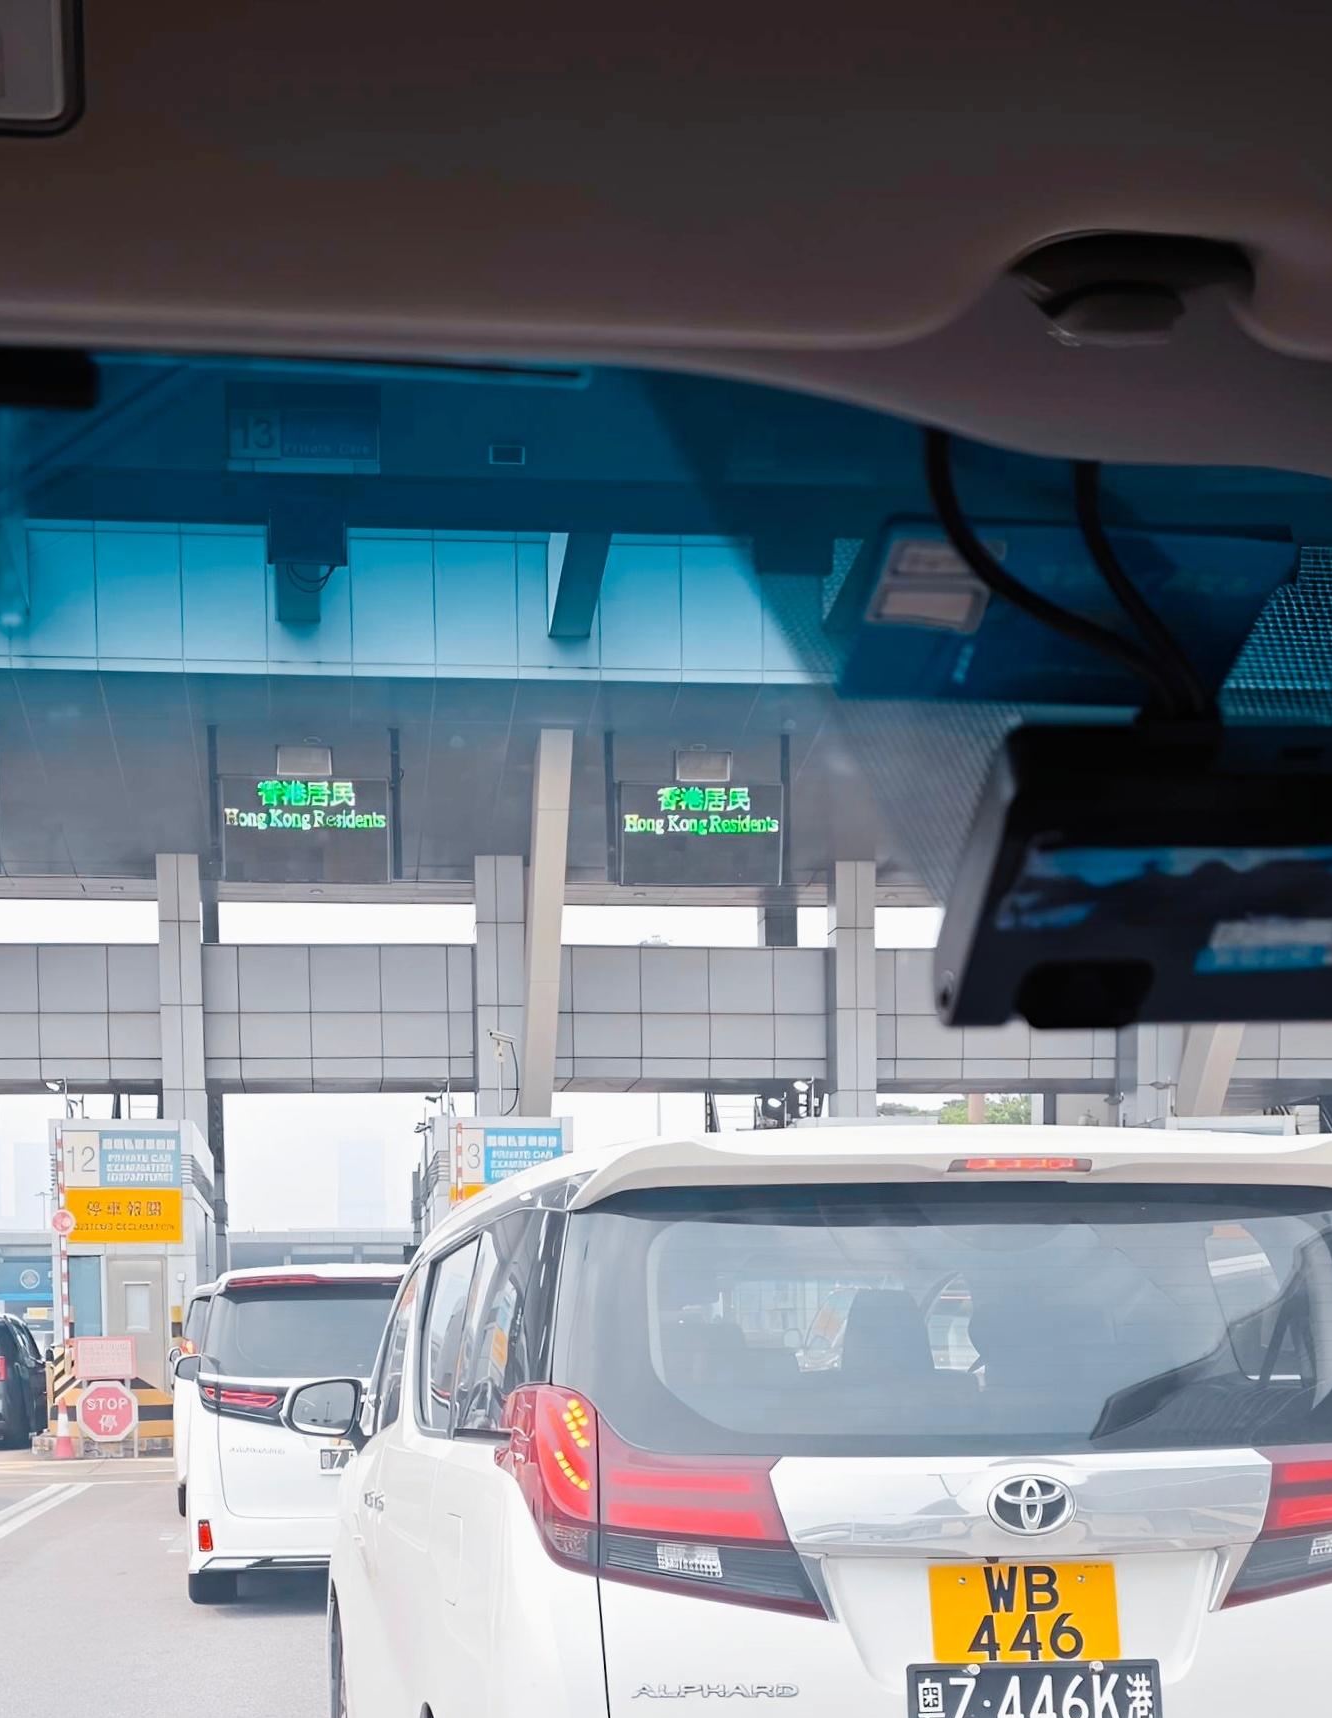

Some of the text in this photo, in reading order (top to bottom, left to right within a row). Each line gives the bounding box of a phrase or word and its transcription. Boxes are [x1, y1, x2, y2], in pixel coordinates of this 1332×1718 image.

[230, 415, 274, 449] 13
[257, 780, 355, 807] 香港居民
[657, 786, 750, 811] 香港居民
[224, 808, 386, 830] Hong Kong Residents
[624, 815, 779, 835] Hong Kong Residents
[67, 1146, 96, 1173] 12
[86, 1398, 129, 1411] STOP
[983, 1565, 1060, 1613] WB
[967, 1612, 1085, 1661] 446
[631, 1683, 799, 1699] ALPHARD
